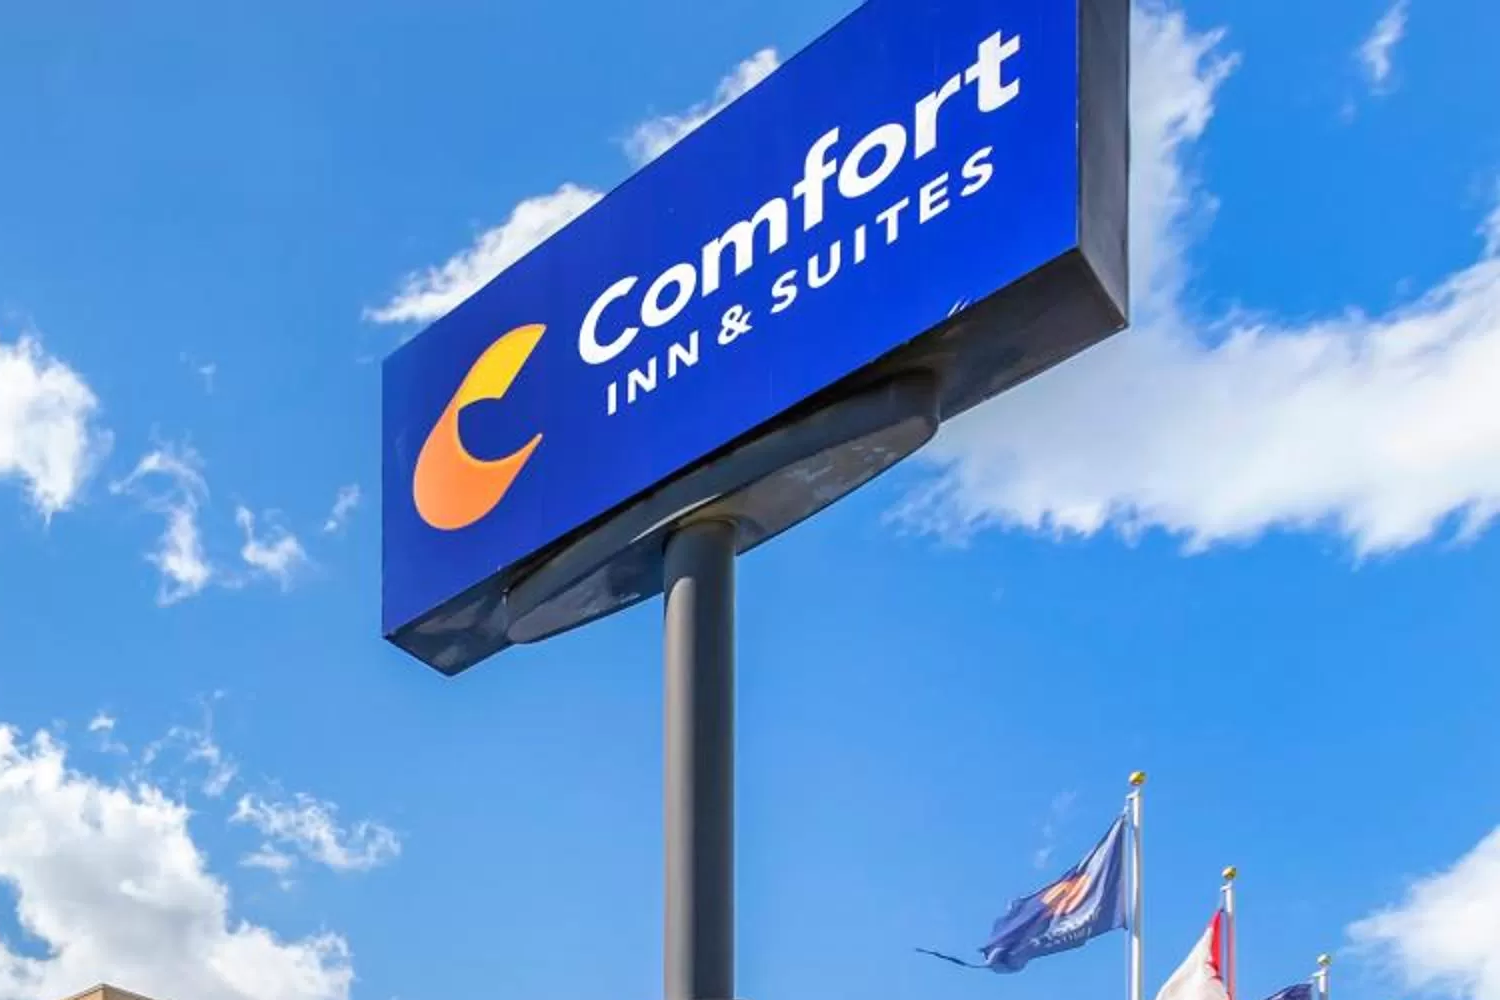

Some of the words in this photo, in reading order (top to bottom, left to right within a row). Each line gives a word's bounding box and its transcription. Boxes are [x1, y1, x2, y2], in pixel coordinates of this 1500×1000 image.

[578, 30, 1020, 365] Comfort
[606, 331, 699, 416] INN
[717, 304, 753, 346] &
[771, 147, 994, 314] SUITES
